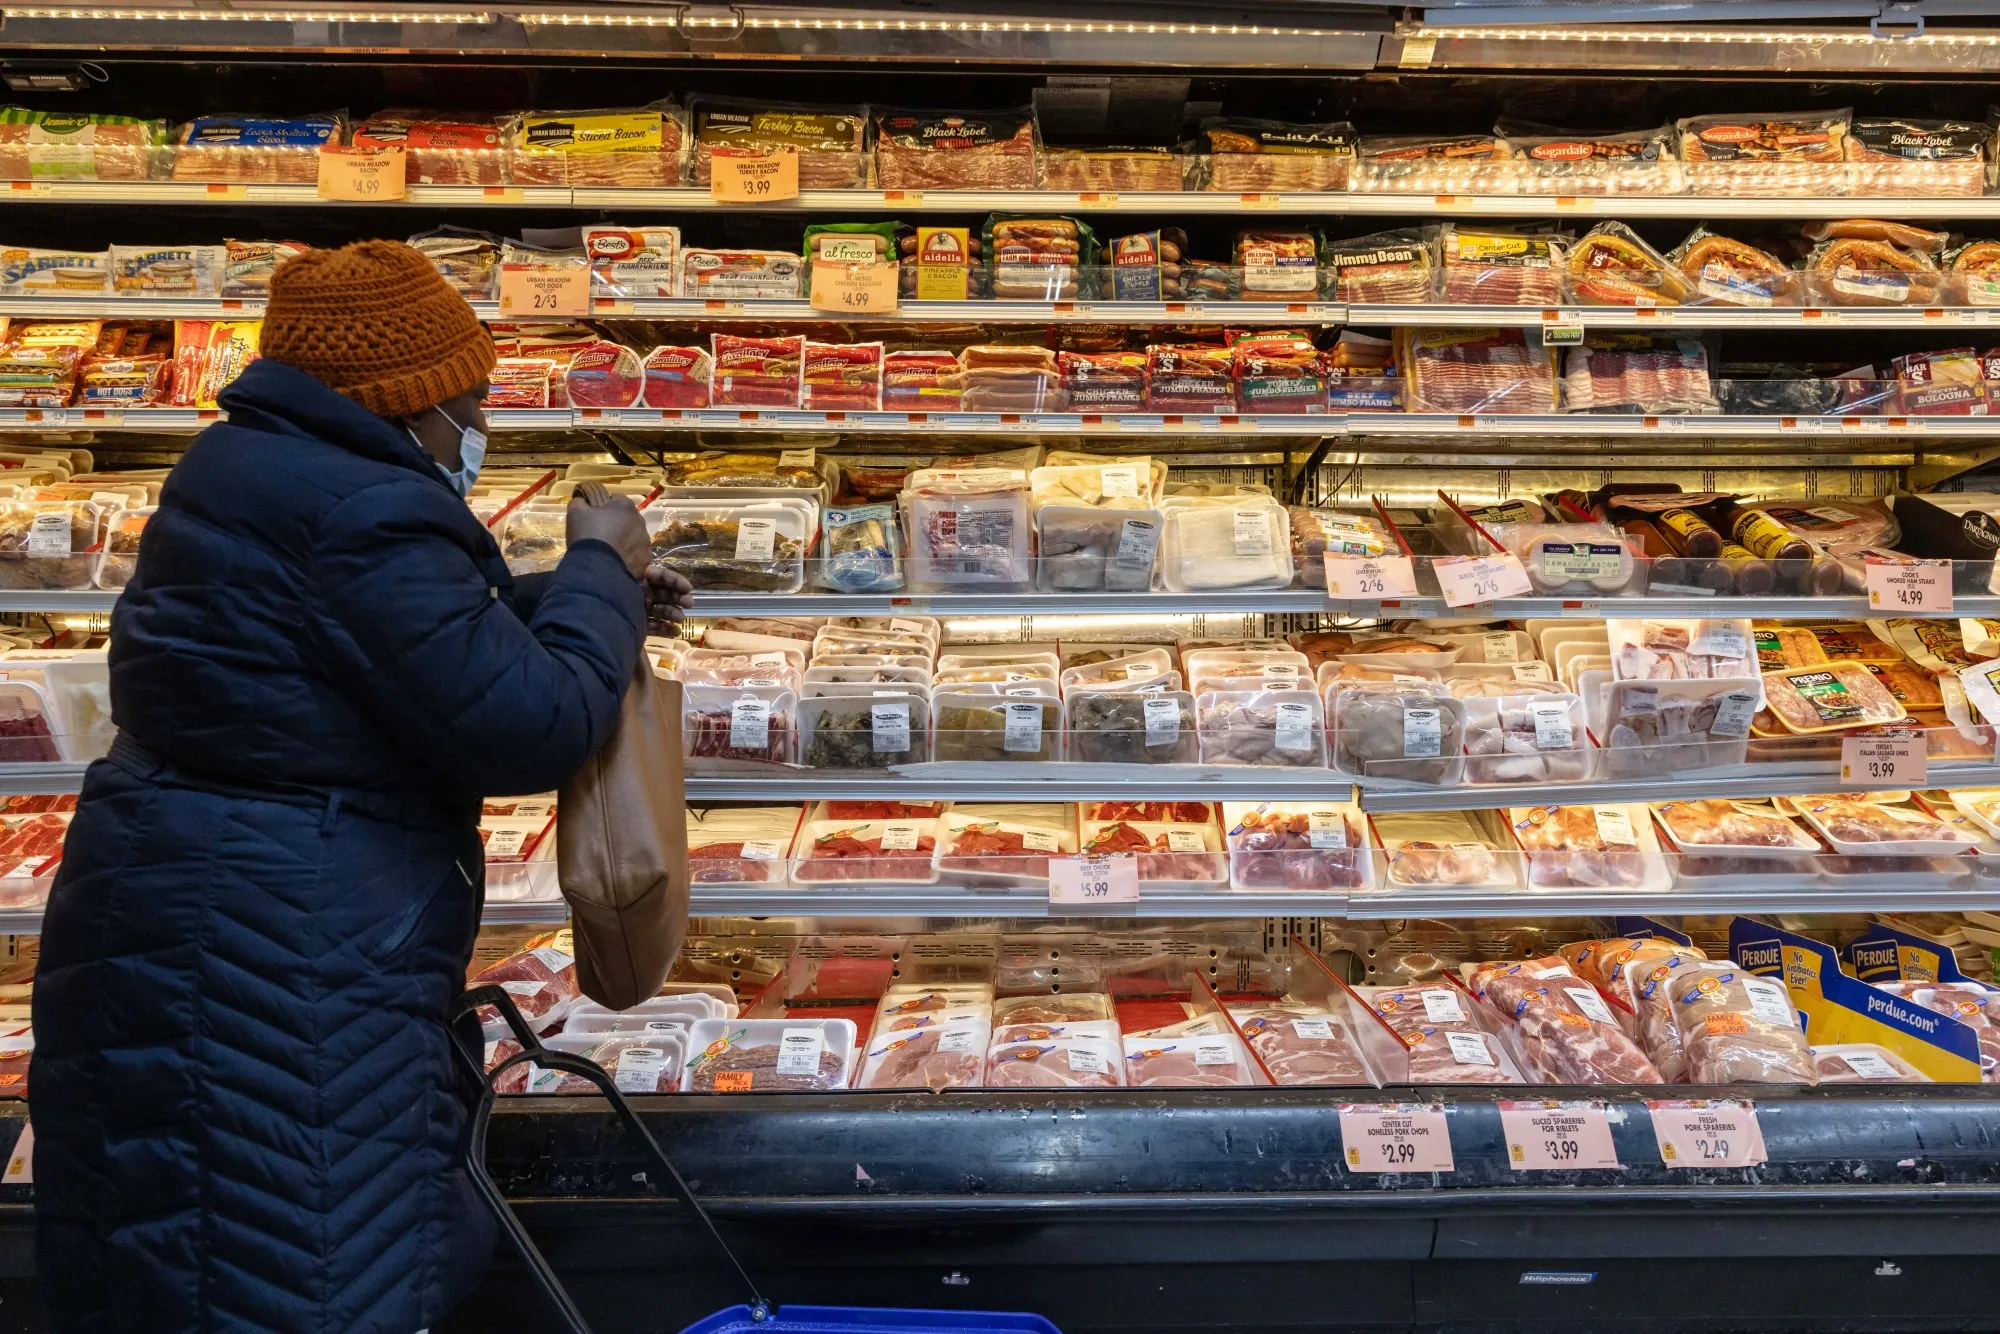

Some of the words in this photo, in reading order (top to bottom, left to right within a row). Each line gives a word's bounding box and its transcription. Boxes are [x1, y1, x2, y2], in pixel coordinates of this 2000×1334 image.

[41, 116, 89, 128] Jennie-O
[710, 113, 728, 121] URBAN
[728, 115, 750, 123] MEADOW
[549, 128, 571, 137] MEADOW
[757, 118, 793, 134] Turkey
[794, 121, 825, 135] Bacon
[922, 127, 957, 138] Black
[957, 126, 987, 136] Label
[43, 135, 82, 144] TURKEY
[578, 132, 612, 142] Sliced
[613, 128, 647, 140] Bacon
[1703, 129, 1759, 141] Sugardale
[1890, 133, 1923, 146] Black
[1923, 134, 1953, 147] Label
[428, 136, 458, 147] Bacon
[935, 138, 975, 149] ORIGINAL
[1533, 143, 1590, 157] Sugardale
[353, 179, 380, 195] $4.99
[743, 180, 771, 195] $3.99
[597, 238, 626, 250] Best's
[1478, 243, 1504, 252] Center
[1505, 242, 1521, 250] Cut
[824, 246, 838, 258] al
[838, 247, 873, 259] fresco
[924, 254, 962, 262] aidells
[1002, 248, 1030, 256] HILLSHIRE
[1332, 252, 1378, 267] Jimmy
[1378, 249, 1413, 263] Dean
[123, 250, 192, 277] SABRETT
[693, 256, 720, 267] Best's
[1118, 254, 1153, 265] aidells
[1, 255, 97, 284] SABRETT
[1122, 274, 1151, 283] CHICKEN
[842, 292, 869, 306] $4.99
[651, 354, 692, 365] Gwaltney
[1162, 358, 1175, 372] S
[1077, 366, 1088, 380] S
[1252, 361, 1264, 374] S
[1907, 363, 1926, 373] BAR
[1171, 380, 1214, 388] CHICKEN
[1266, 380, 1300, 388] TURKEY
[1330, 372, 1342, 384] S
[1911, 371, 1924, 385] S
[96, 388, 112, 396] HOT
[113, 388, 134, 396] DOGS
[1086, 388, 1129, 396] CHICKEN
[1159, 386, 1190, 394] JUMBO
[1250, 387, 1281, 395] JUMBO
[1281, 385, 1317, 394] FRANKS
[1928, 386, 1958, 395] CHICKEN
[1074, 394, 1104, 402] JUMBO
[1104, 394, 1141, 402] FRANKS
[1917, 390, 1970, 404] BOLOGNA
[1964, 520, 2000, 543] D'ARTAGNAN
[1472, 564, 1489, 572] JONES
[1546, 561, 1588, 569] CANADIAN
[1897, 590, 1923, 606] $4.99
[1790, 672, 1834, 686] PREMIO
[1868, 762, 1895, 778] $3.99
[1080, 882, 1109, 898] $5.99
[1741, 946, 1781, 966] PERDUE
[1793, 952, 1803, 963] No
[1856, 948, 1897, 967] PERDUE
[1910, 952, 1920, 963] No
[1786, 962, 1817, 981] Antibiotics
[1902, 962, 1934, 980] Antibiotics
[1790, 972, 1808, 986] Ever!
[1706, 1014, 1735, 1024] FAMILY
[1868, 994, 1935, 1034] perdue.com
[1722, 1026, 1746, 1034] SAVE
[717, 1072, 744, 1082] FAMILY
[1382, 1120, 1399, 1128] CENTER
[1400, 1120, 1412, 1128] CUT
[1532, 1118, 1552, 1126] SLICED
[1698, 1116, 1718, 1124] FRESH
[1368, 1128, 1394, 1136] BONELESS
[1394, 1128, 1409, 1136] PORK
[1410, 1128, 1429, 1136] CHOPS
[1684, 1124, 1702, 1132] PORK
[1382, 1144, 1415, 1164] $2.99
[1545, 1140, 1578, 1160] $3.99
[1696, 1140, 1729, 1159] $2.49
[1524, 1274, 1588, 1284] Hillphoenix
